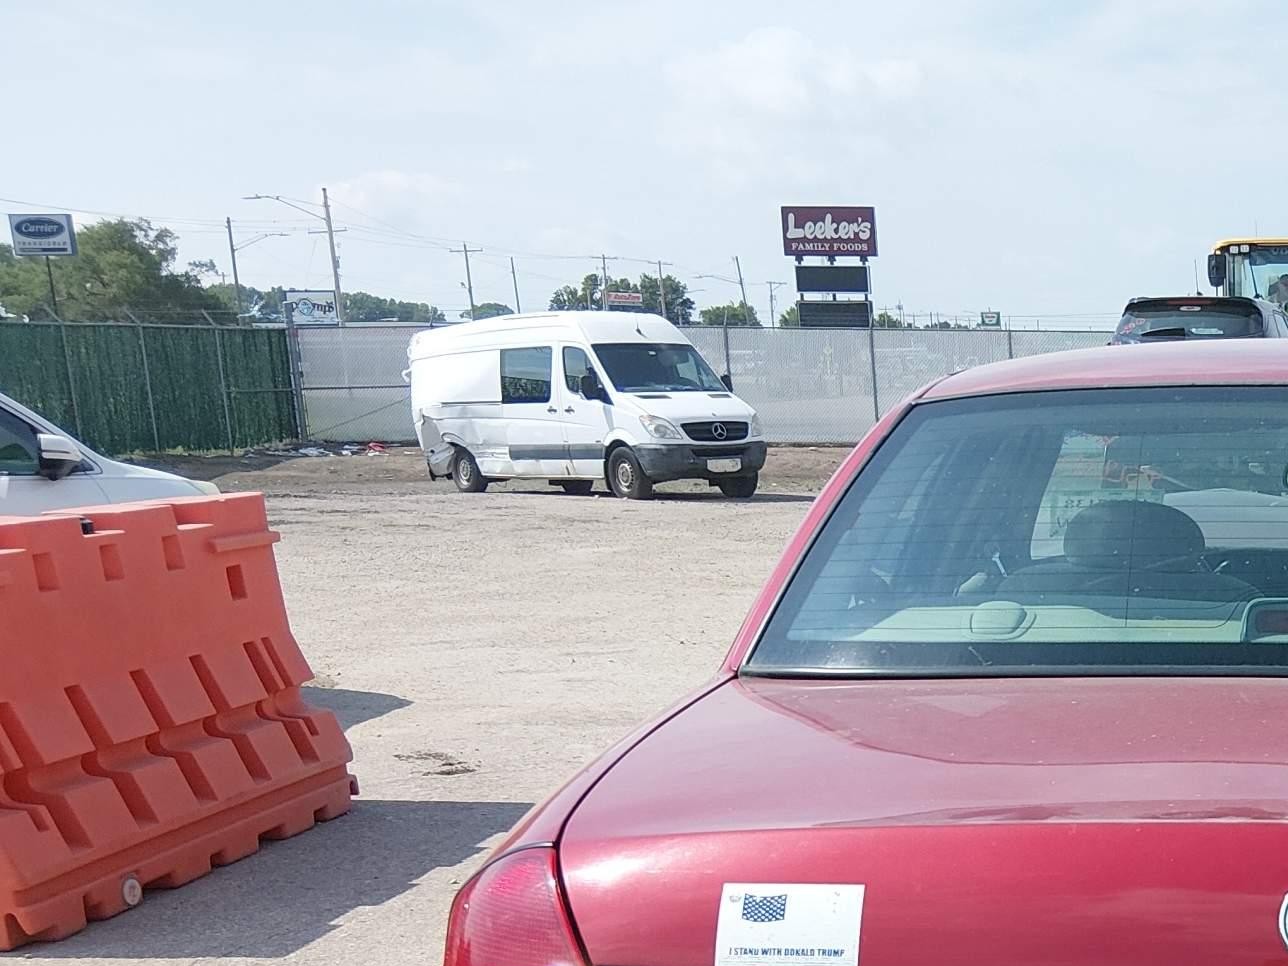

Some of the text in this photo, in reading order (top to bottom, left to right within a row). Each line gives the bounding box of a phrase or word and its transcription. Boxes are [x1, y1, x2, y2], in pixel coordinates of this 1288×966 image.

[21, 222, 60, 232] Carrier
[786, 212, 872, 240] Leeker's
[791, 242, 869, 251] FAMILY FOODS
[760, 947, 783, 957] WITH
[817, 948, 846, 958] TRUMP
